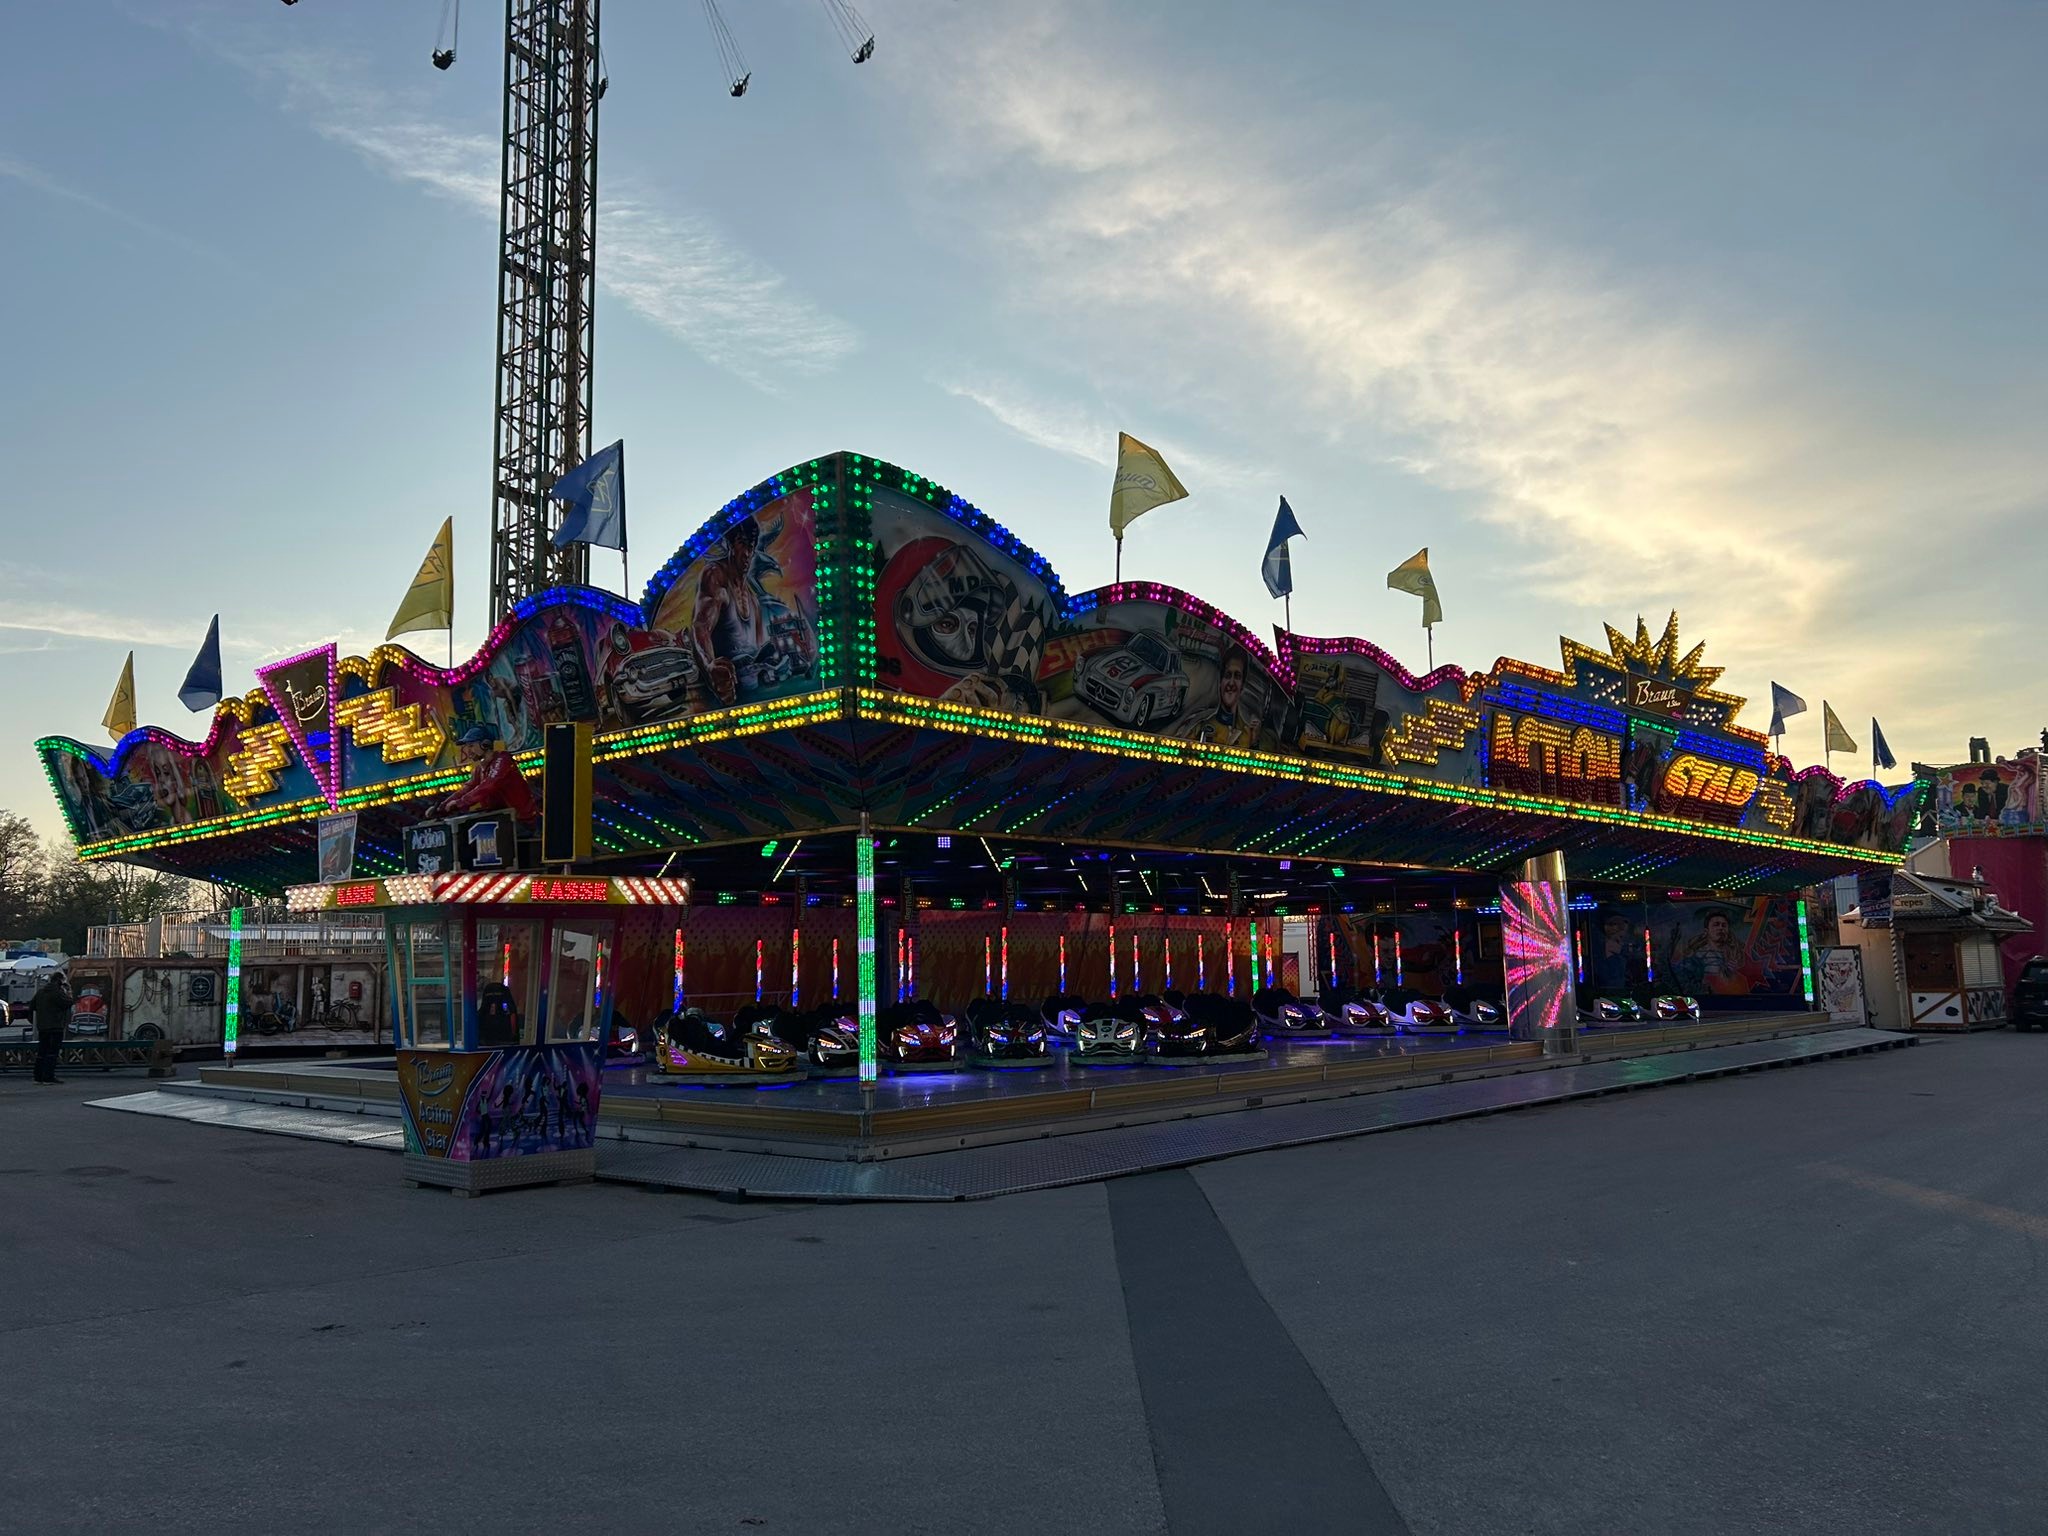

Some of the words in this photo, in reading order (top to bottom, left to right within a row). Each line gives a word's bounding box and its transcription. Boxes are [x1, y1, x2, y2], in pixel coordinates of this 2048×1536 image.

[290, 684, 326, 720] Braun
[1635, 680, 1676, 706] Braun
[1489, 711, 1622, 805] ACTION
[1654, 754, 1760, 828] STAR
[412, 828, 446, 850] Action
[418, 853, 441, 873] Star
[531, 881, 607, 901] KASSE
[419, 1101, 453, 1124] Action
[425, 1128, 448, 1150] Star
